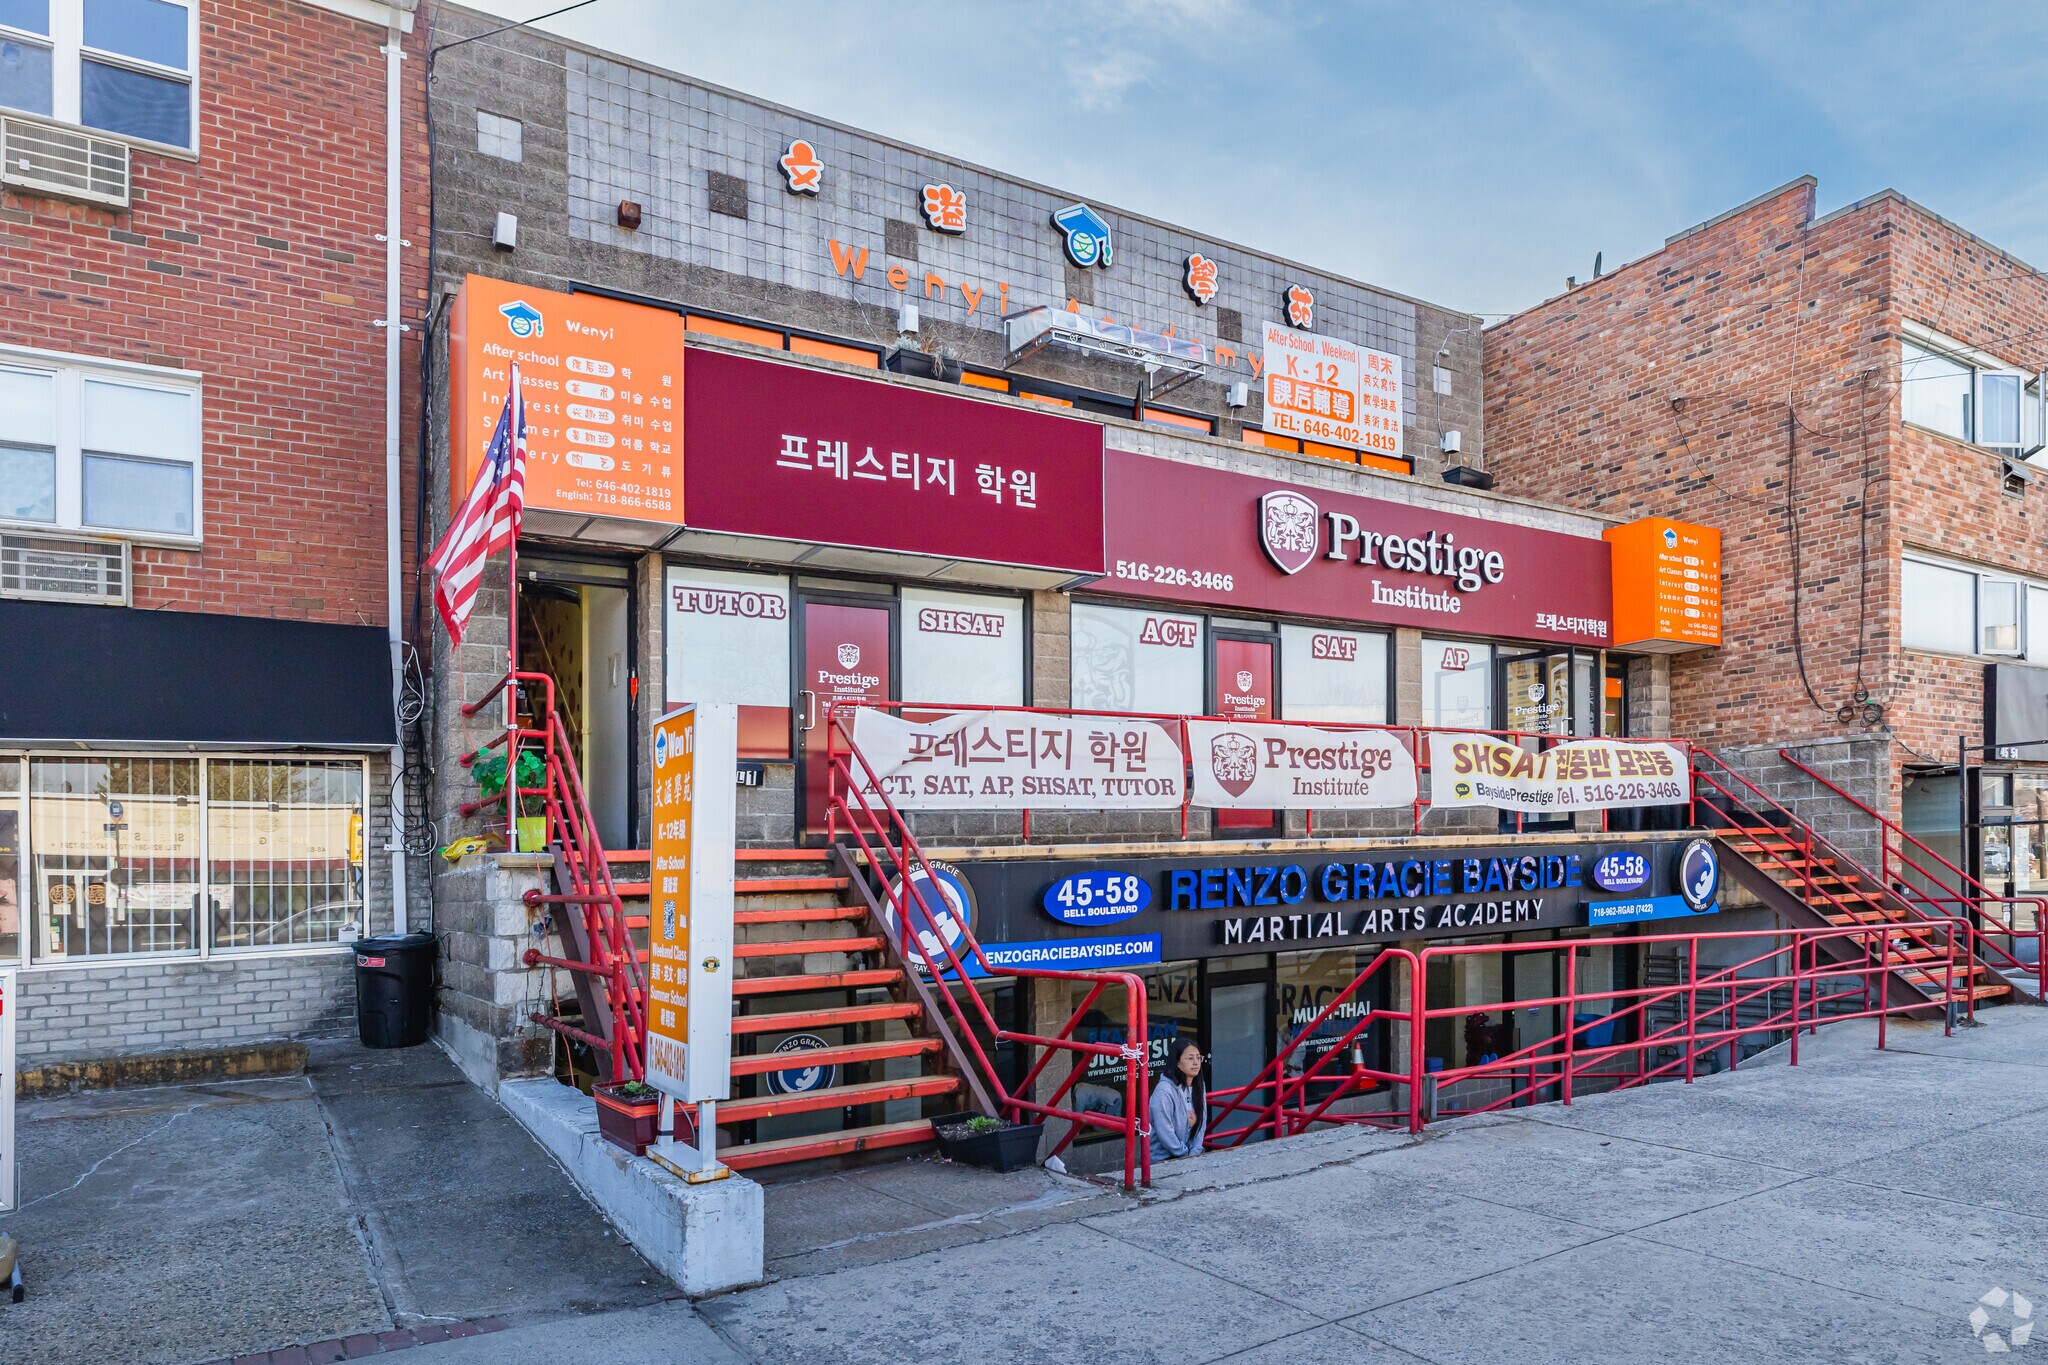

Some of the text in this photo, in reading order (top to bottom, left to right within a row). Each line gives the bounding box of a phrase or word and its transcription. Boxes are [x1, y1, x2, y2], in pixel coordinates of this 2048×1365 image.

[566, 319, 614, 341] Wenyi
[483, 342, 560, 368] After school
[1268, 327, 1287, 345] After
[1321, 341, 1356, 363] Weekend
[1367, 353, 1393, 375] 周末
[482, 367, 560, 391] Art lasses
[483, 391, 560, 415] Intrest
[620, 390, 672, 410] 미술 수업
[483, 416, 560, 437] Smer
[621, 414, 672, 433] 취미 수업
[1272, 412, 1396, 451] TEL: 646-402-1819
[482, 440, 560, 465] Pery
[621, 437, 672, 455] 여름 학교
[776, 433, 1037, 509] 프레스티지 학원
[556, 488, 672, 512] English: 718-866-6588
[575, 478, 672, 499] Tel: 646-402-1819
[1326, 511, 1505, 593] Prestige
[1115, 559, 1234, 592] 516-226-3466
[1659, 579, 1683, 589] Interest
[673, 586, 787, 620] TUTOR
[1371, 579, 1461, 614] Institute
[1659, 592, 1683, 602] Summer
[919, 608, 1005, 638] SHSAT
[1659, 605, 1684, 617] Pottery
[1140, 618, 1197, 649] ACT
[1535, 611, 1608, 639] 프레스티지학원
[1312, 633, 1357, 662] SAT
[1441, 647, 1470, 671] AP
[818, 670, 880, 689] Prestige
[833, 685, 865, 694] Institute
[1224, 693, 1266, 708] Prestige
[1515, 703, 1560, 716] Prestige
[667, 725, 693, 759] Wen Yi
[902, 726, 1147, 773] 프레스티지 학원
[1263, 737, 1392, 778] Prestige
[1453, 743, 1674, 782] SHSAT 집중반 모집중
[860, 776, 1176, 799] ACT, SAT, AP, SHSAT, TUTOR
[1292, 777, 1370, 797] Institute
[1476, 782, 1554, 807] BaysidePrestige
[1556, 785, 1579, 806] Tel.
[1583, 781, 1682, 804] 516-226-3466
[656, 853, 686, 871] After School
[930, 860, 960, 878] GRACIE
[1600, 855, 1644, 877] 45-58
[1056, 875, 1140, 908] 45-58
[1171, 853, 1584, 911] RENZO GRACIE BAYSIDE
[1616, 877, 1643, 885] BOULEVARD
[1063, 904, 1138, 919] BELL BOULEVARD
[1223, 898, 1545, 945] MARTIAL ARTS ACADEMY
[1593, 903, 1653, 917] 718-962-RGAB (7422)
[652, 942, 687, 961] Weekend Class
[650, 984, 688, 1008] Summer School
[1145, 974, 1198, 1006] ENZO
